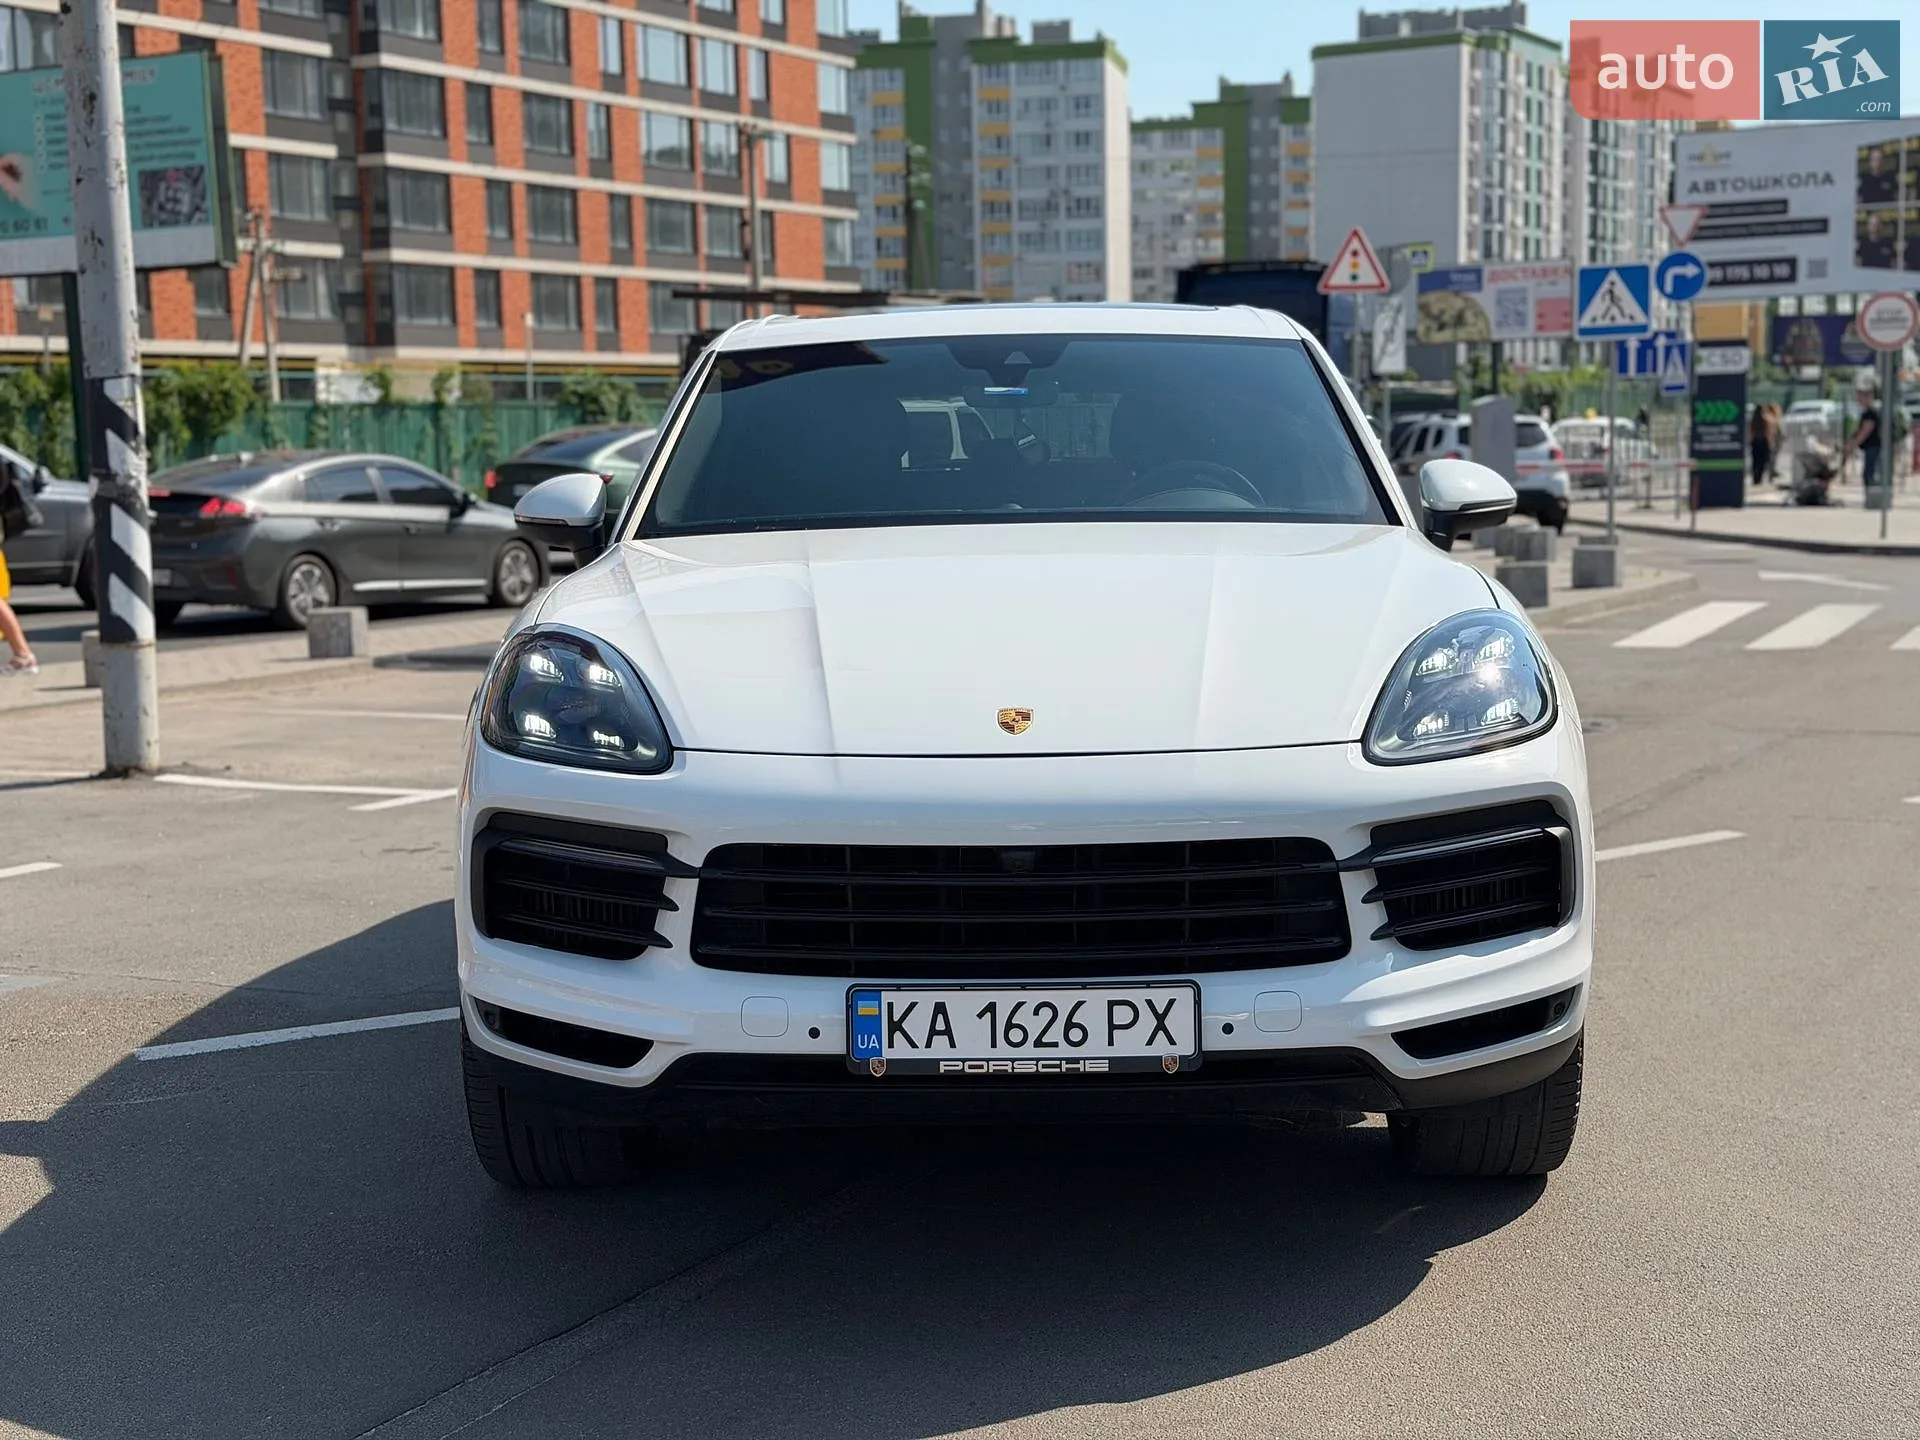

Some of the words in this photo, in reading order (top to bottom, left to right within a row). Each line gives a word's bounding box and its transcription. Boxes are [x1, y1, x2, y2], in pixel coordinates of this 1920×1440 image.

[1687, 172, 1835, 195] АВТОШКОЛА
[1488, 265, 1572, 285] ДОСТАВКА
[886, 1001, 957, 1050] KA
[976, 1000, 1089, 1050] 1626
[1106, 998, 1178, 1047] PX
[858, 1034, 880, 1050] UA
[939, 1059, 1110, 1074] PORSCHE
